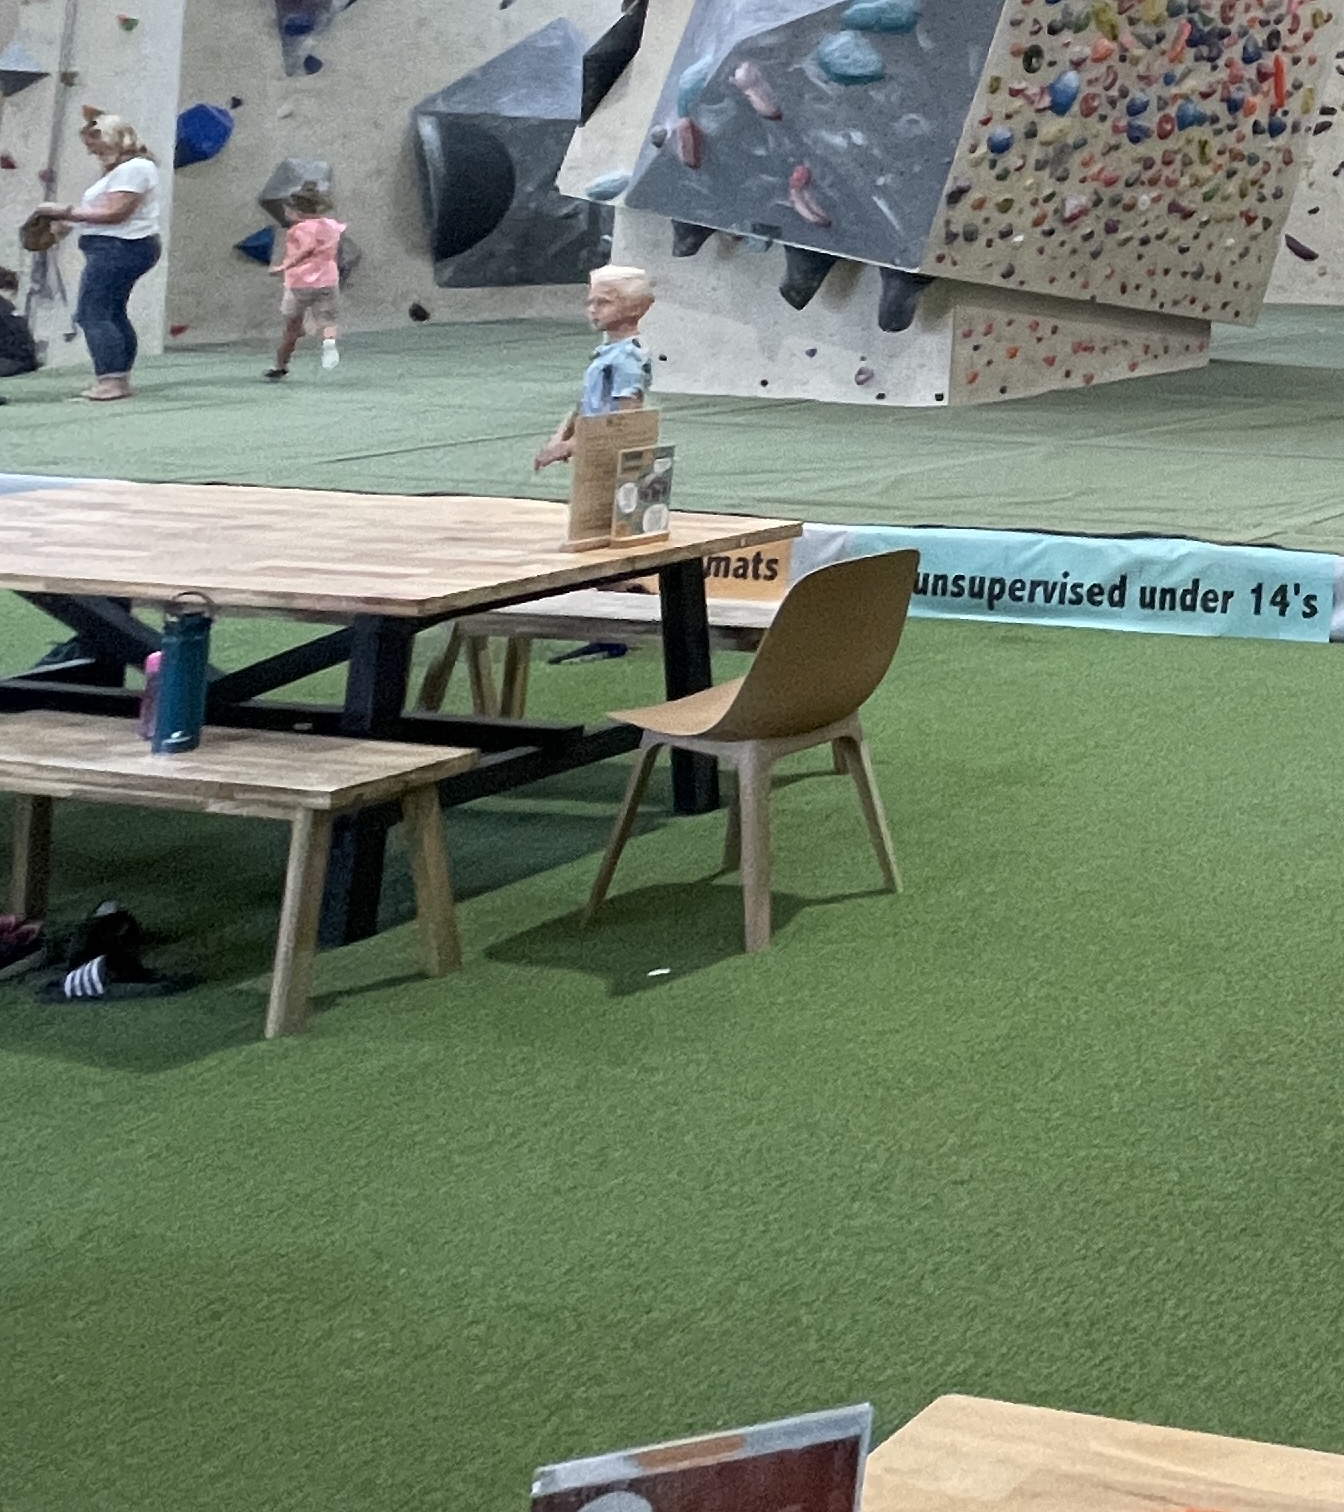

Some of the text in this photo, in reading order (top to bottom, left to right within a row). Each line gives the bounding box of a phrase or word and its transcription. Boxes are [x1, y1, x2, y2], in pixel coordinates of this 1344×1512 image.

[706, 550, 780, 582] mats
[913, 570, 1319, 619] unsupervised under 14's
